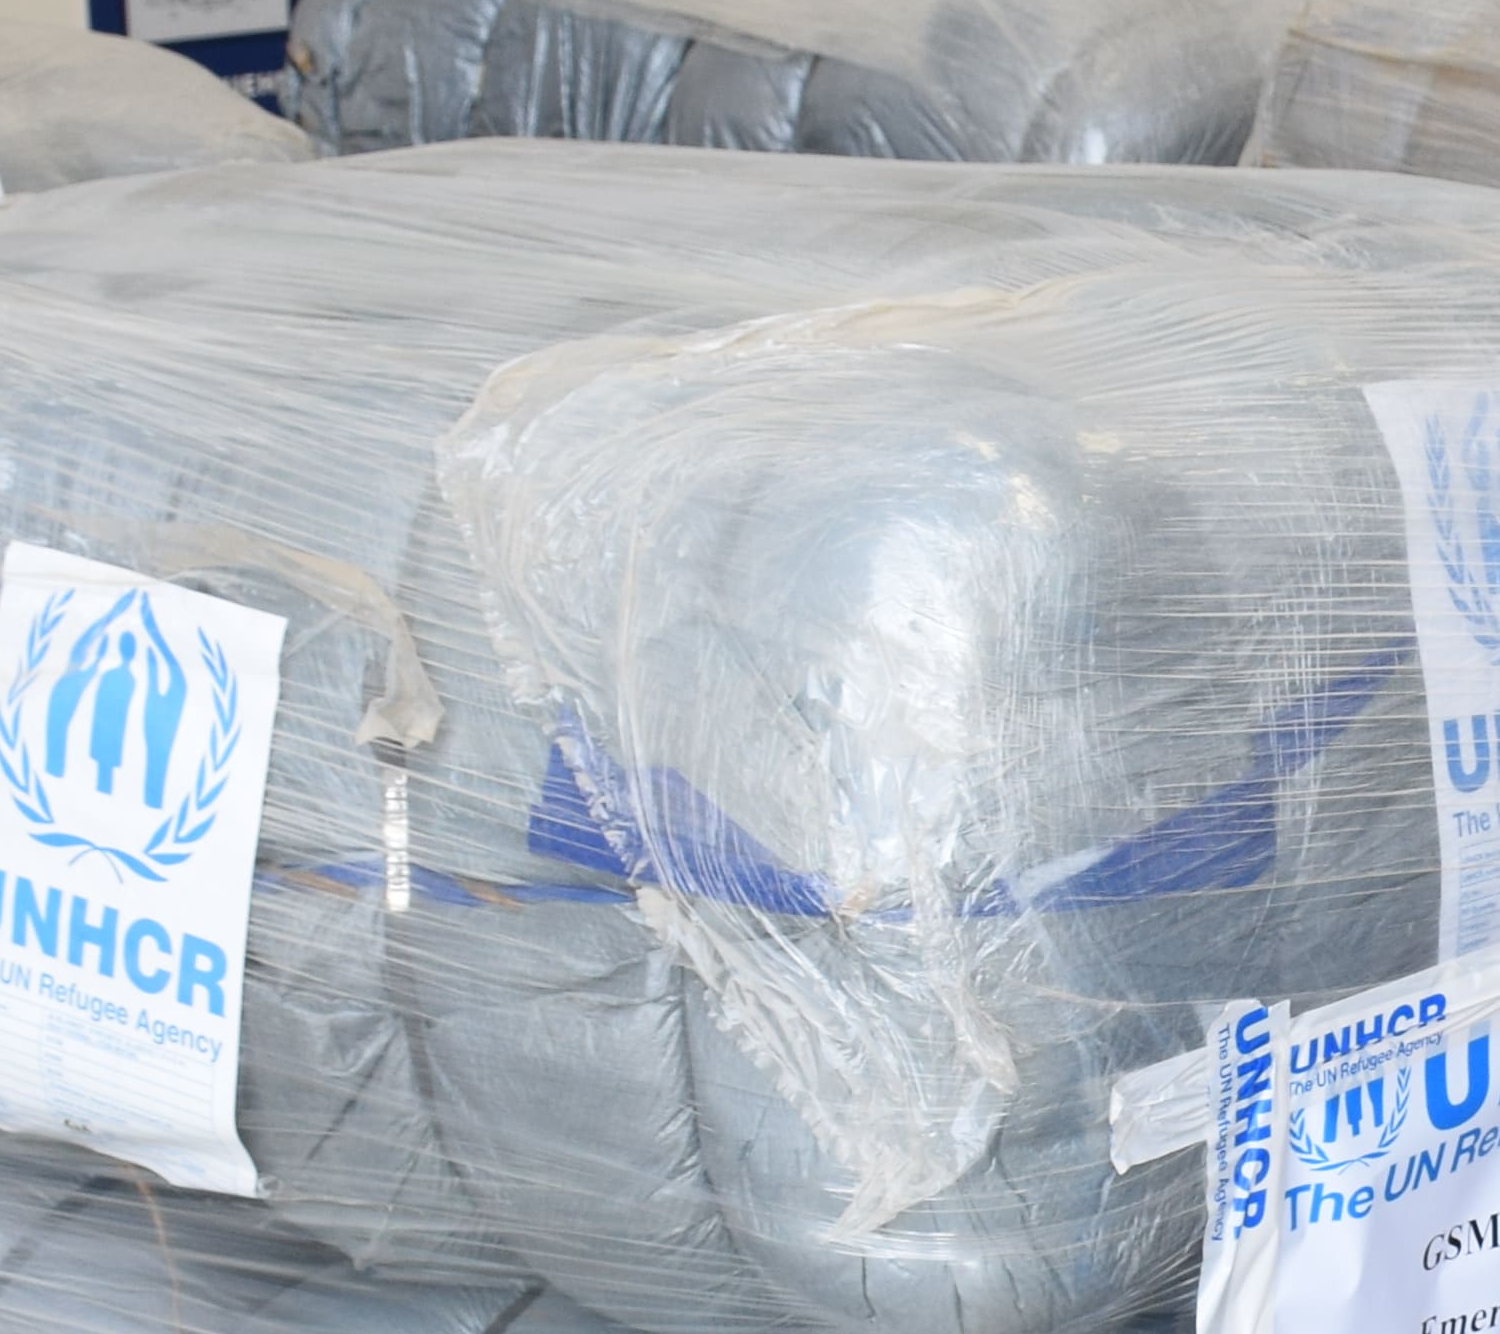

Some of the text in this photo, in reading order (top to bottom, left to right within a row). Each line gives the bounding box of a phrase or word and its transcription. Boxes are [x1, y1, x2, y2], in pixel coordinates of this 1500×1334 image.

[1452, 809, 1491, 839] The
[0, 958, 31, 992] UN
[38, 972, 130, 1023] Refugee
[134, 1008, 223, 1064] Agency
[1289, 993, 1447, 1075] UNHCR
[1284, 1182, 1375, 1233] The
[1383, 1142, 1451, 1203] UN
[1421, 1212, 1500, 1272] GSM
